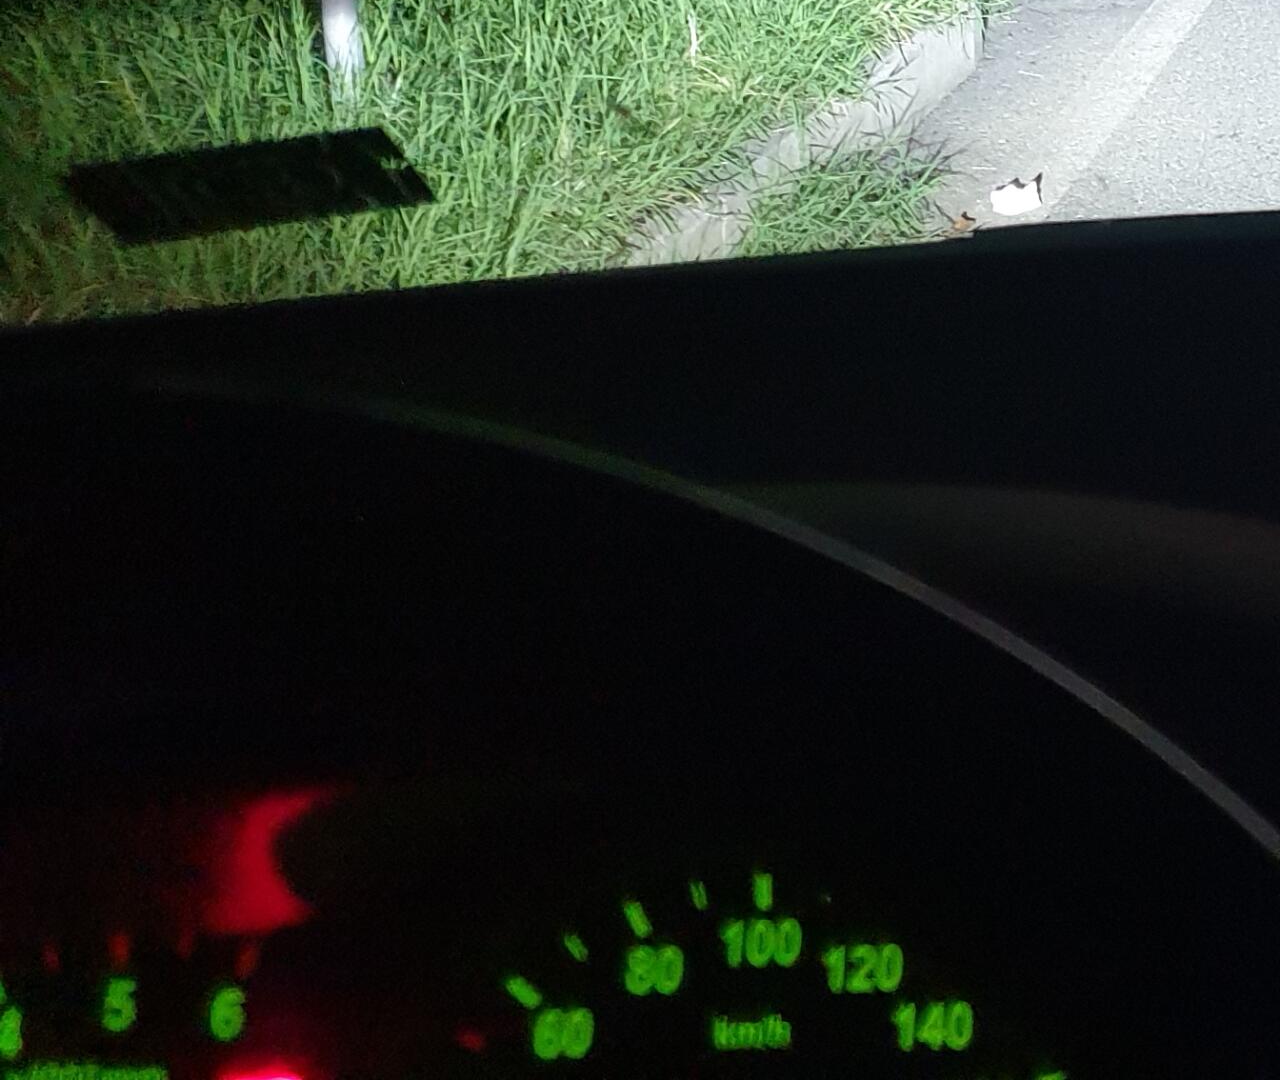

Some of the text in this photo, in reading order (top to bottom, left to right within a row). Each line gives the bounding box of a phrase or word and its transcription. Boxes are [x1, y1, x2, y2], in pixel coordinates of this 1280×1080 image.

[720, 918, 802, 968] 100
[823, 942, 904, 994] 120
[624, 944, 685, 997] 80
[101, 976, 138, 1033] 5
[209, 986, 247, 1042] 6
[892, 999, 974, 1051] 140
[532, 1006, 595, 1060] 60
[712, 1013, 792, 1050] km/h
